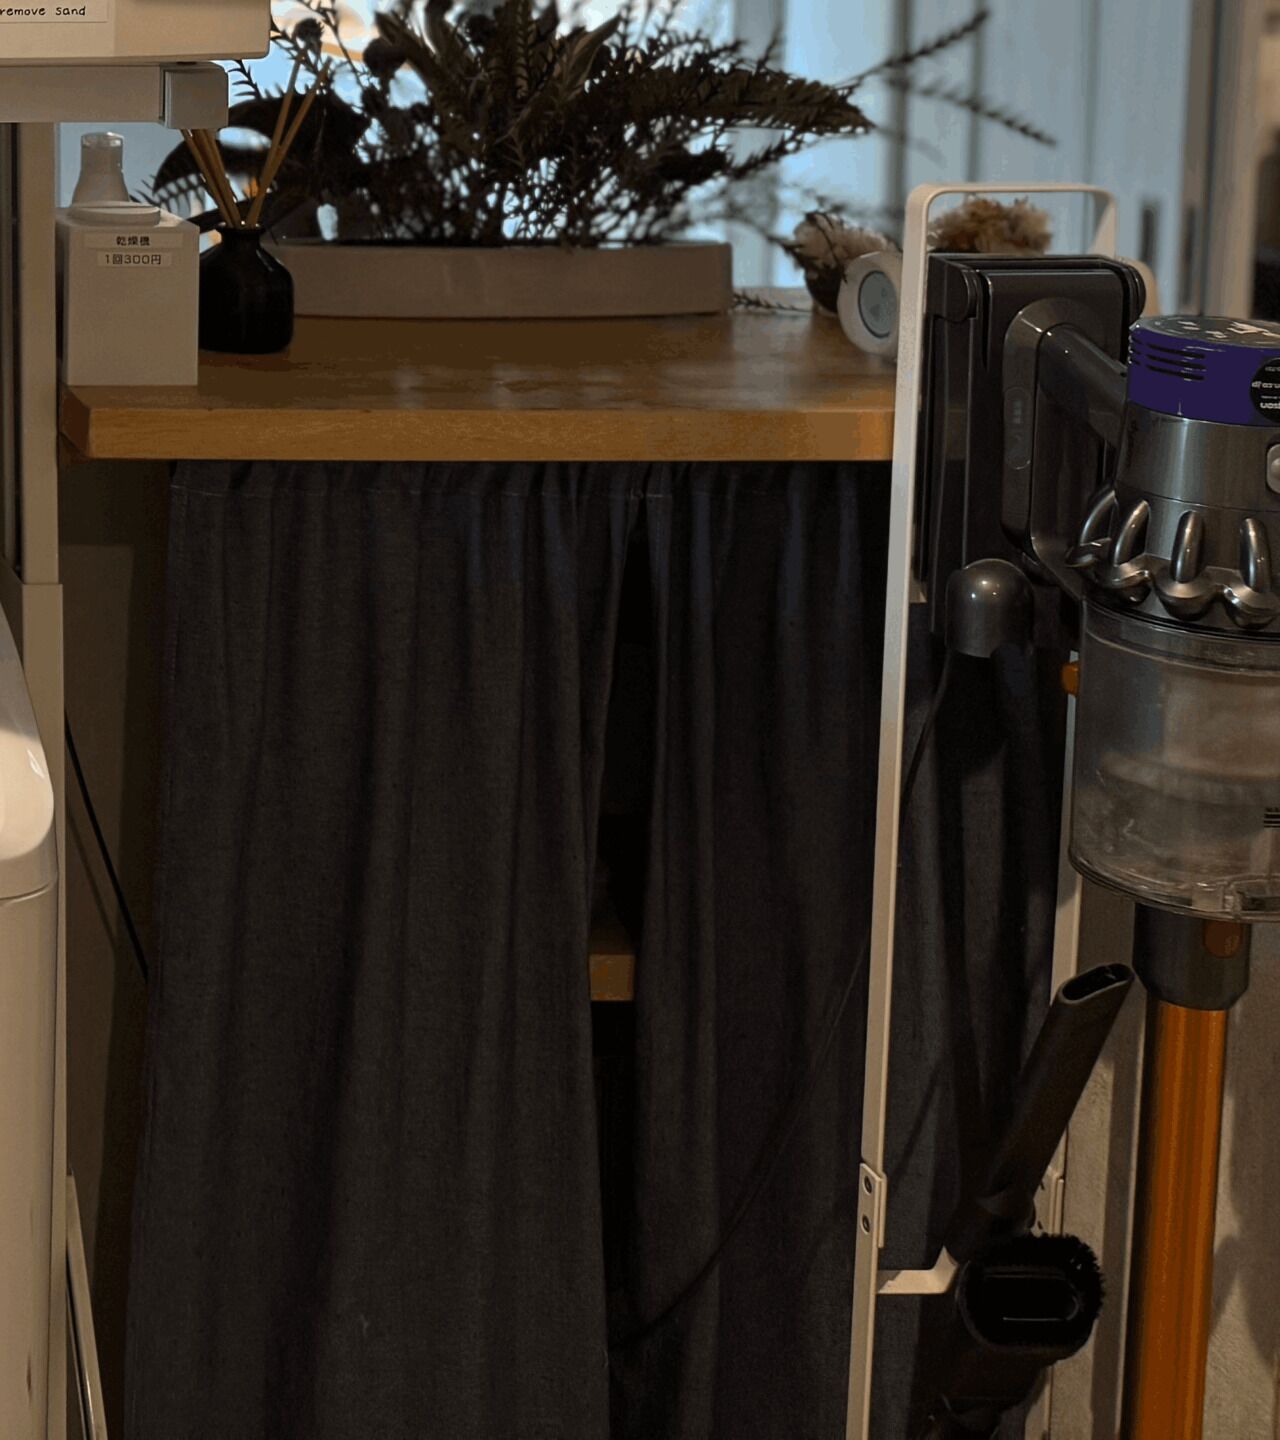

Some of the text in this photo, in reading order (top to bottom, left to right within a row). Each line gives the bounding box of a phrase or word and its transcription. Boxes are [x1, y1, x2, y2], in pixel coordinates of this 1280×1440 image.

[0, 7, 46, 17] remove
[55, 6, 86, 17] sand
[116, 236, 150, 246] 乾燥機
[105, 254, 161, 265] 1回300円
